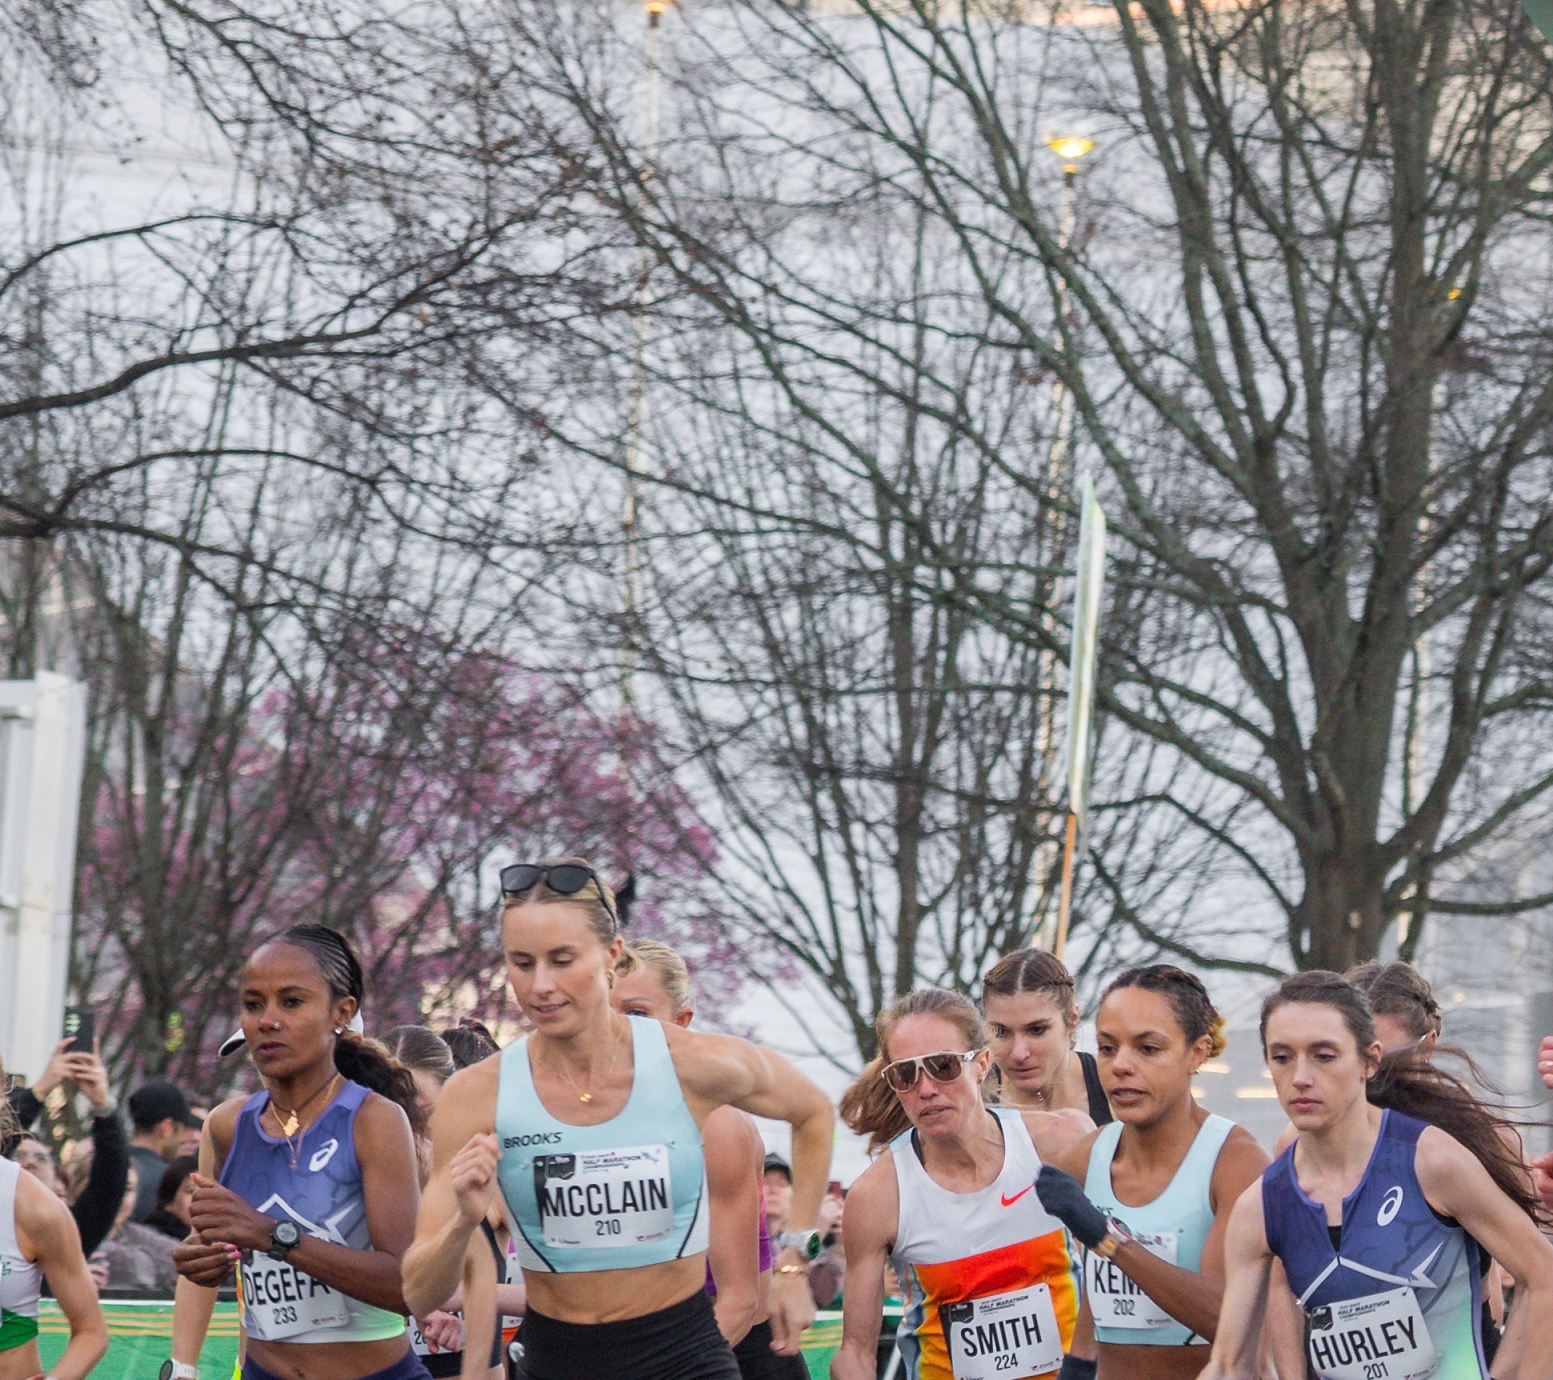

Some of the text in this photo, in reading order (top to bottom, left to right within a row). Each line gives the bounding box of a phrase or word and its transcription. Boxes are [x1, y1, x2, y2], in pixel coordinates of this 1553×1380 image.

[504, 1132, 562, 1148] BROOKS
[542, 1178, 668, 1217] MCCLAIN
[596, 1219, 621, 1236] 210
[272, 1306, 297, 1325] 233
[1113, 1299, 1135, 1316] 202
[960, 1313, 1043, 1357] SMITH
[1312, 1316, 1418, 1370] HURLEY
[994, 1353, 1019, 1371] 224
[1363, 1362, 1389, 1380] 201
